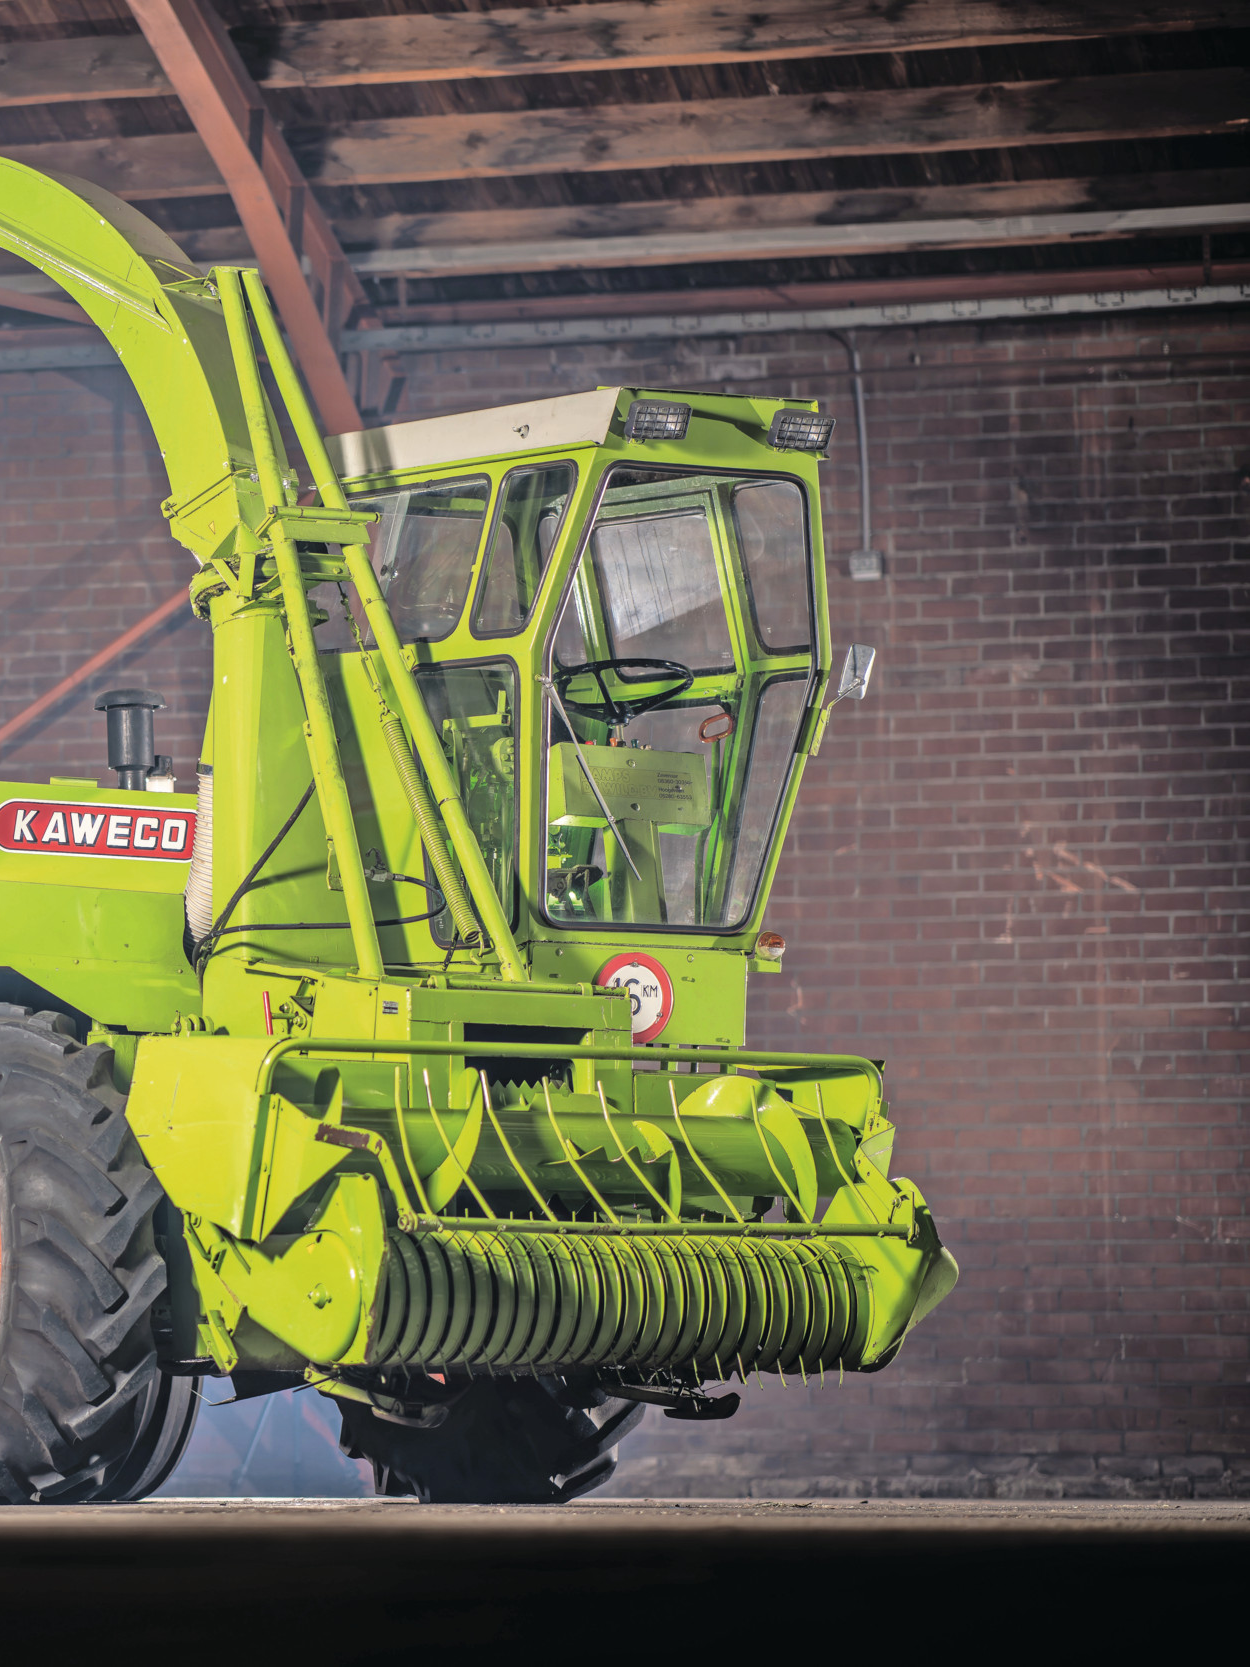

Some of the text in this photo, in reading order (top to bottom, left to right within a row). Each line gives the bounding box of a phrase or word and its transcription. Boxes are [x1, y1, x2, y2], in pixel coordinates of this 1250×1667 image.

[580, 768, 631, 783] AMPS
[13, 809, 188, 853] KAWECO
[613, 977, 659, 1016] 6 KM
